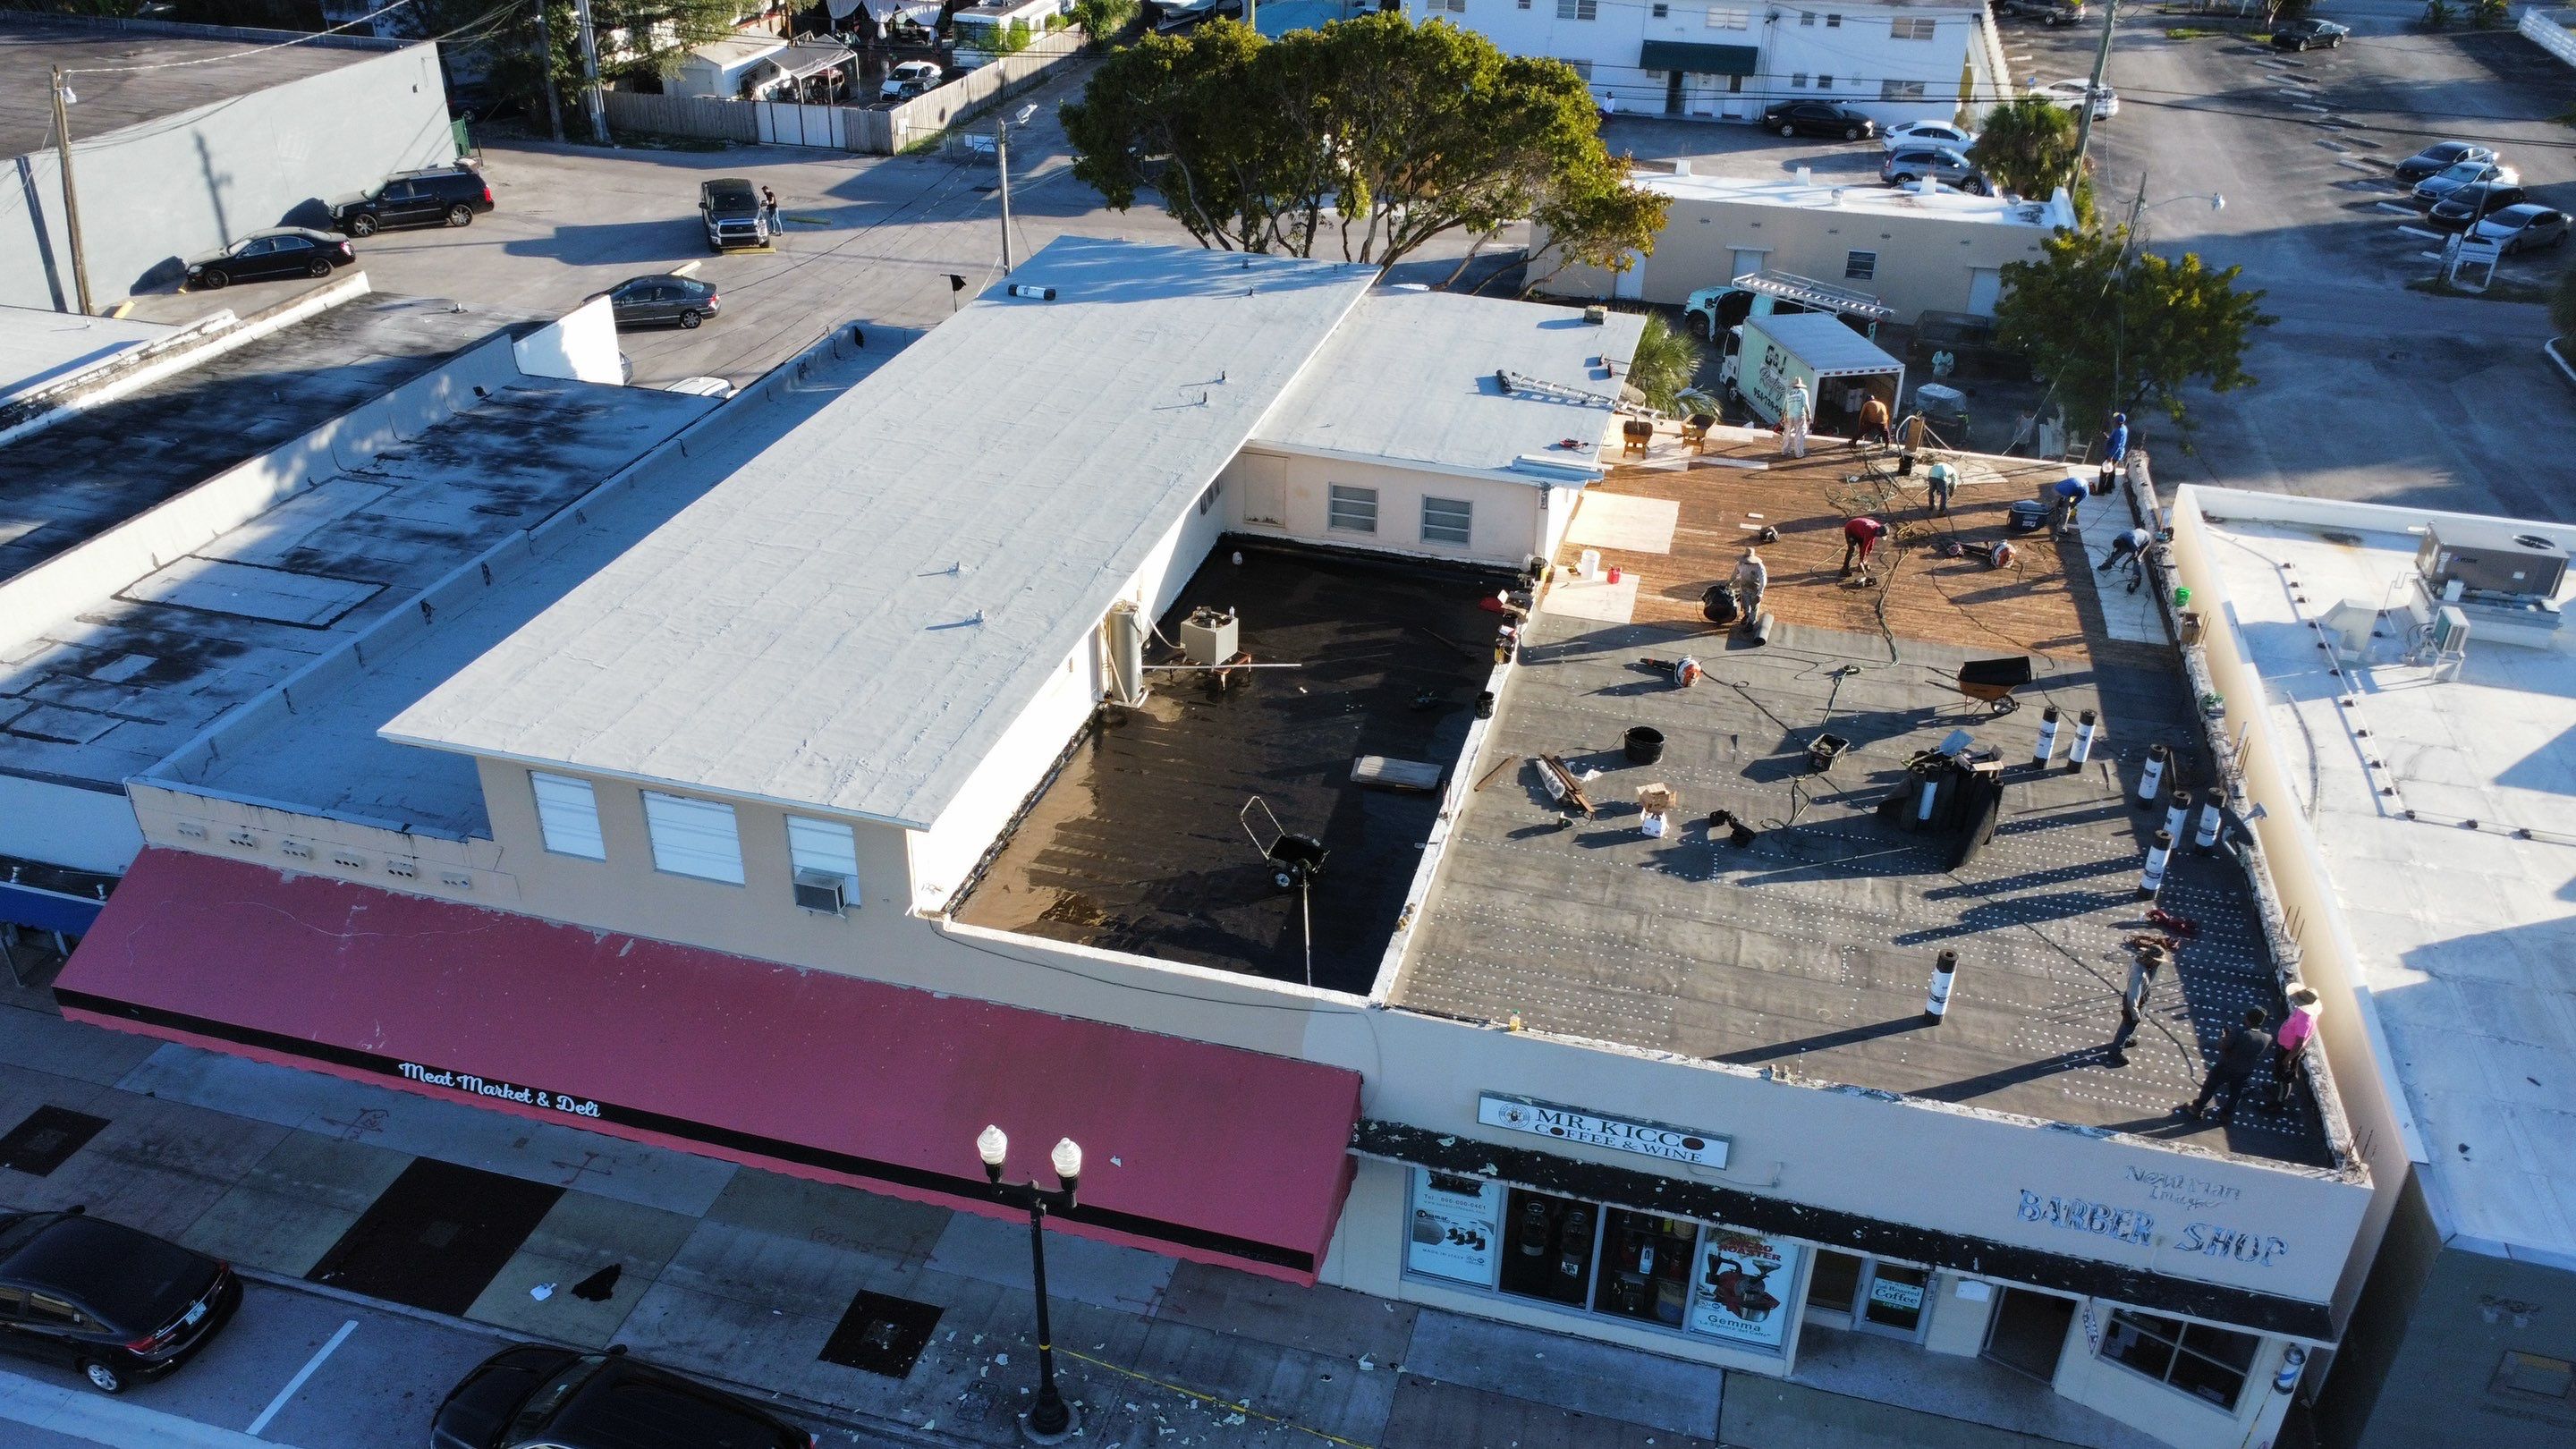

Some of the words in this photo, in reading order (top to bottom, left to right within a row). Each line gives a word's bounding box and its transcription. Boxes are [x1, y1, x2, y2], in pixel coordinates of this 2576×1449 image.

[398, 1062, 455, 1088] Meat
[456, 1074, 534, 1105] Market
[537, 1091, 550, 1108] &
[555, 1095, 601, 1118] Deli
[1535, 1123, 1616, 1148] COFFEE
[1623, 1140, 1639, 1151] &
[1642, 1142, 1703, 1163] WINE
[1536, 1108, 1592, 1131] MR.
[1599, 1120, 1707, 1151] KICCO
[2017, 1189, 2155, 1246] BARBER
[2174, 1222, 2290, 1267] SHOP
[1875, 1288, 1918, 1303] Coffee
[1707, 1314, 1761, 1332] Gemma
